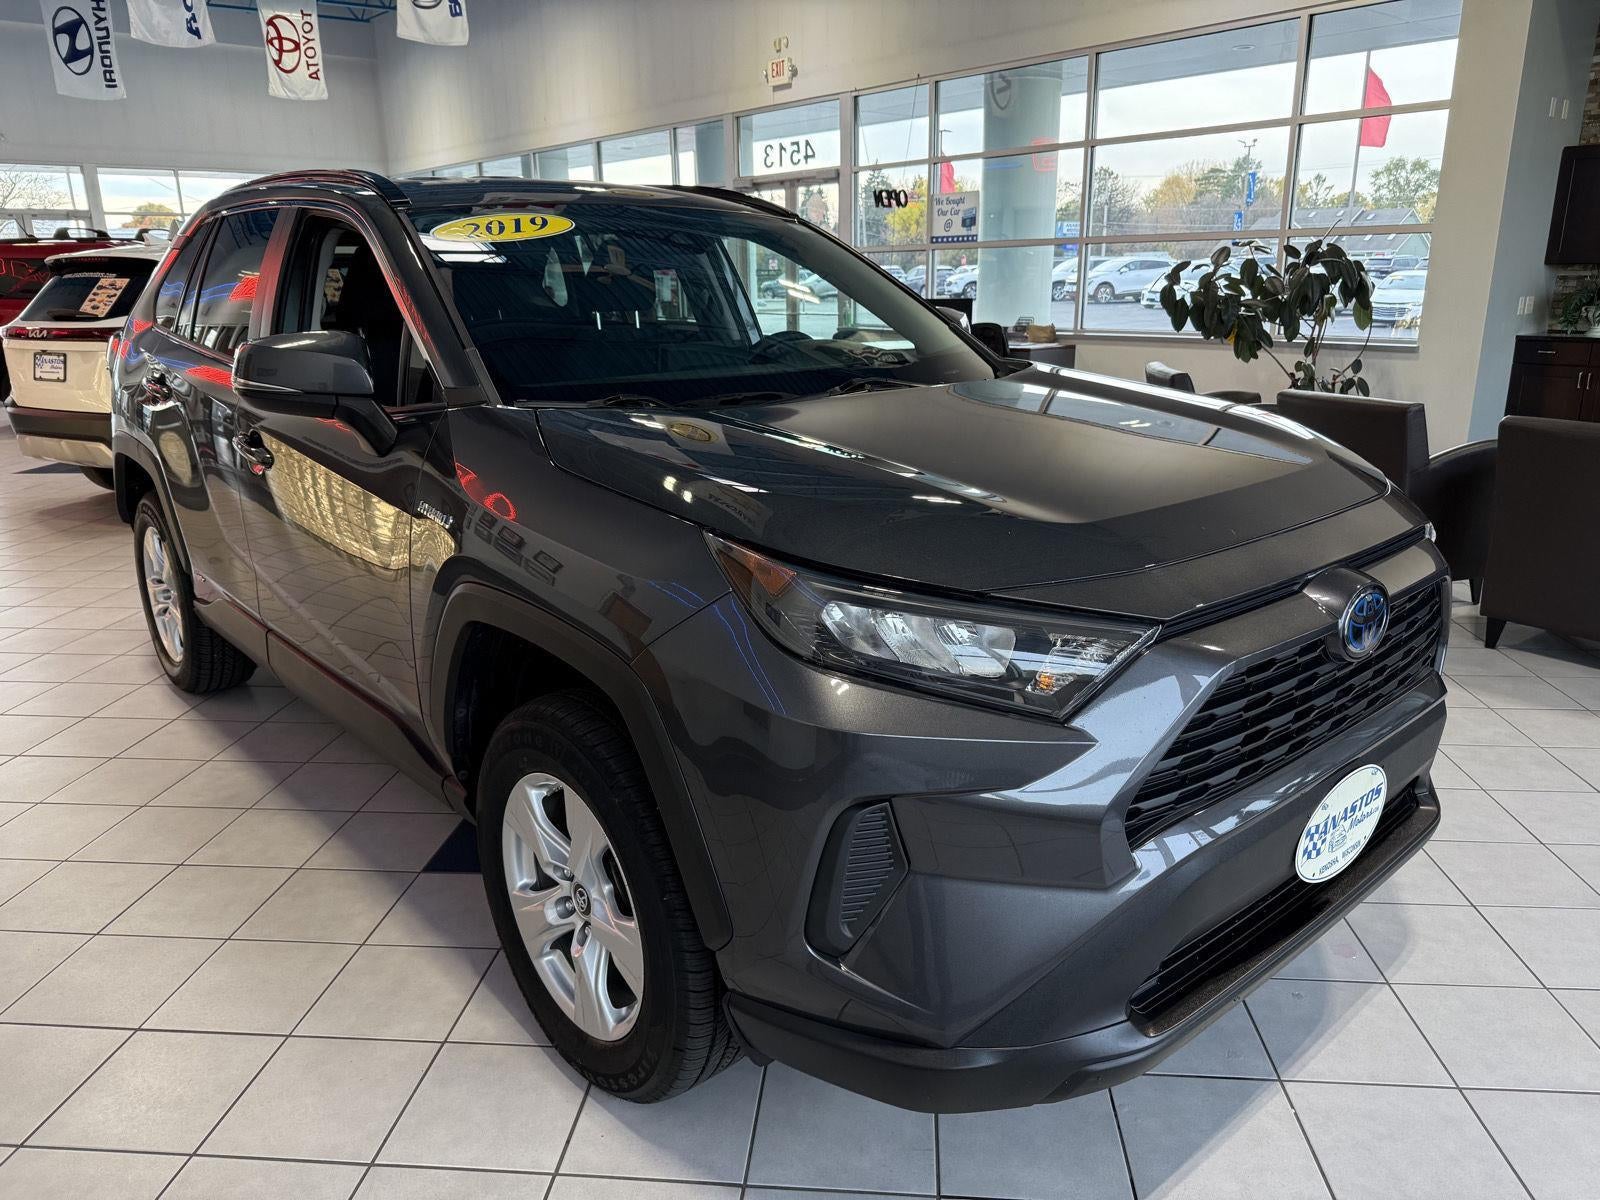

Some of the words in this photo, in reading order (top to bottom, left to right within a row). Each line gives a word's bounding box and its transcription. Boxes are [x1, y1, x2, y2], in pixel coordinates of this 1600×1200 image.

[771, 60, 785, 79] EXIT
[935, 197, 944, 206] We
[945, 196, 965, 207] Bought
[937, 208, 948, 217] Our
[463, 216, 548, 238] 2019
